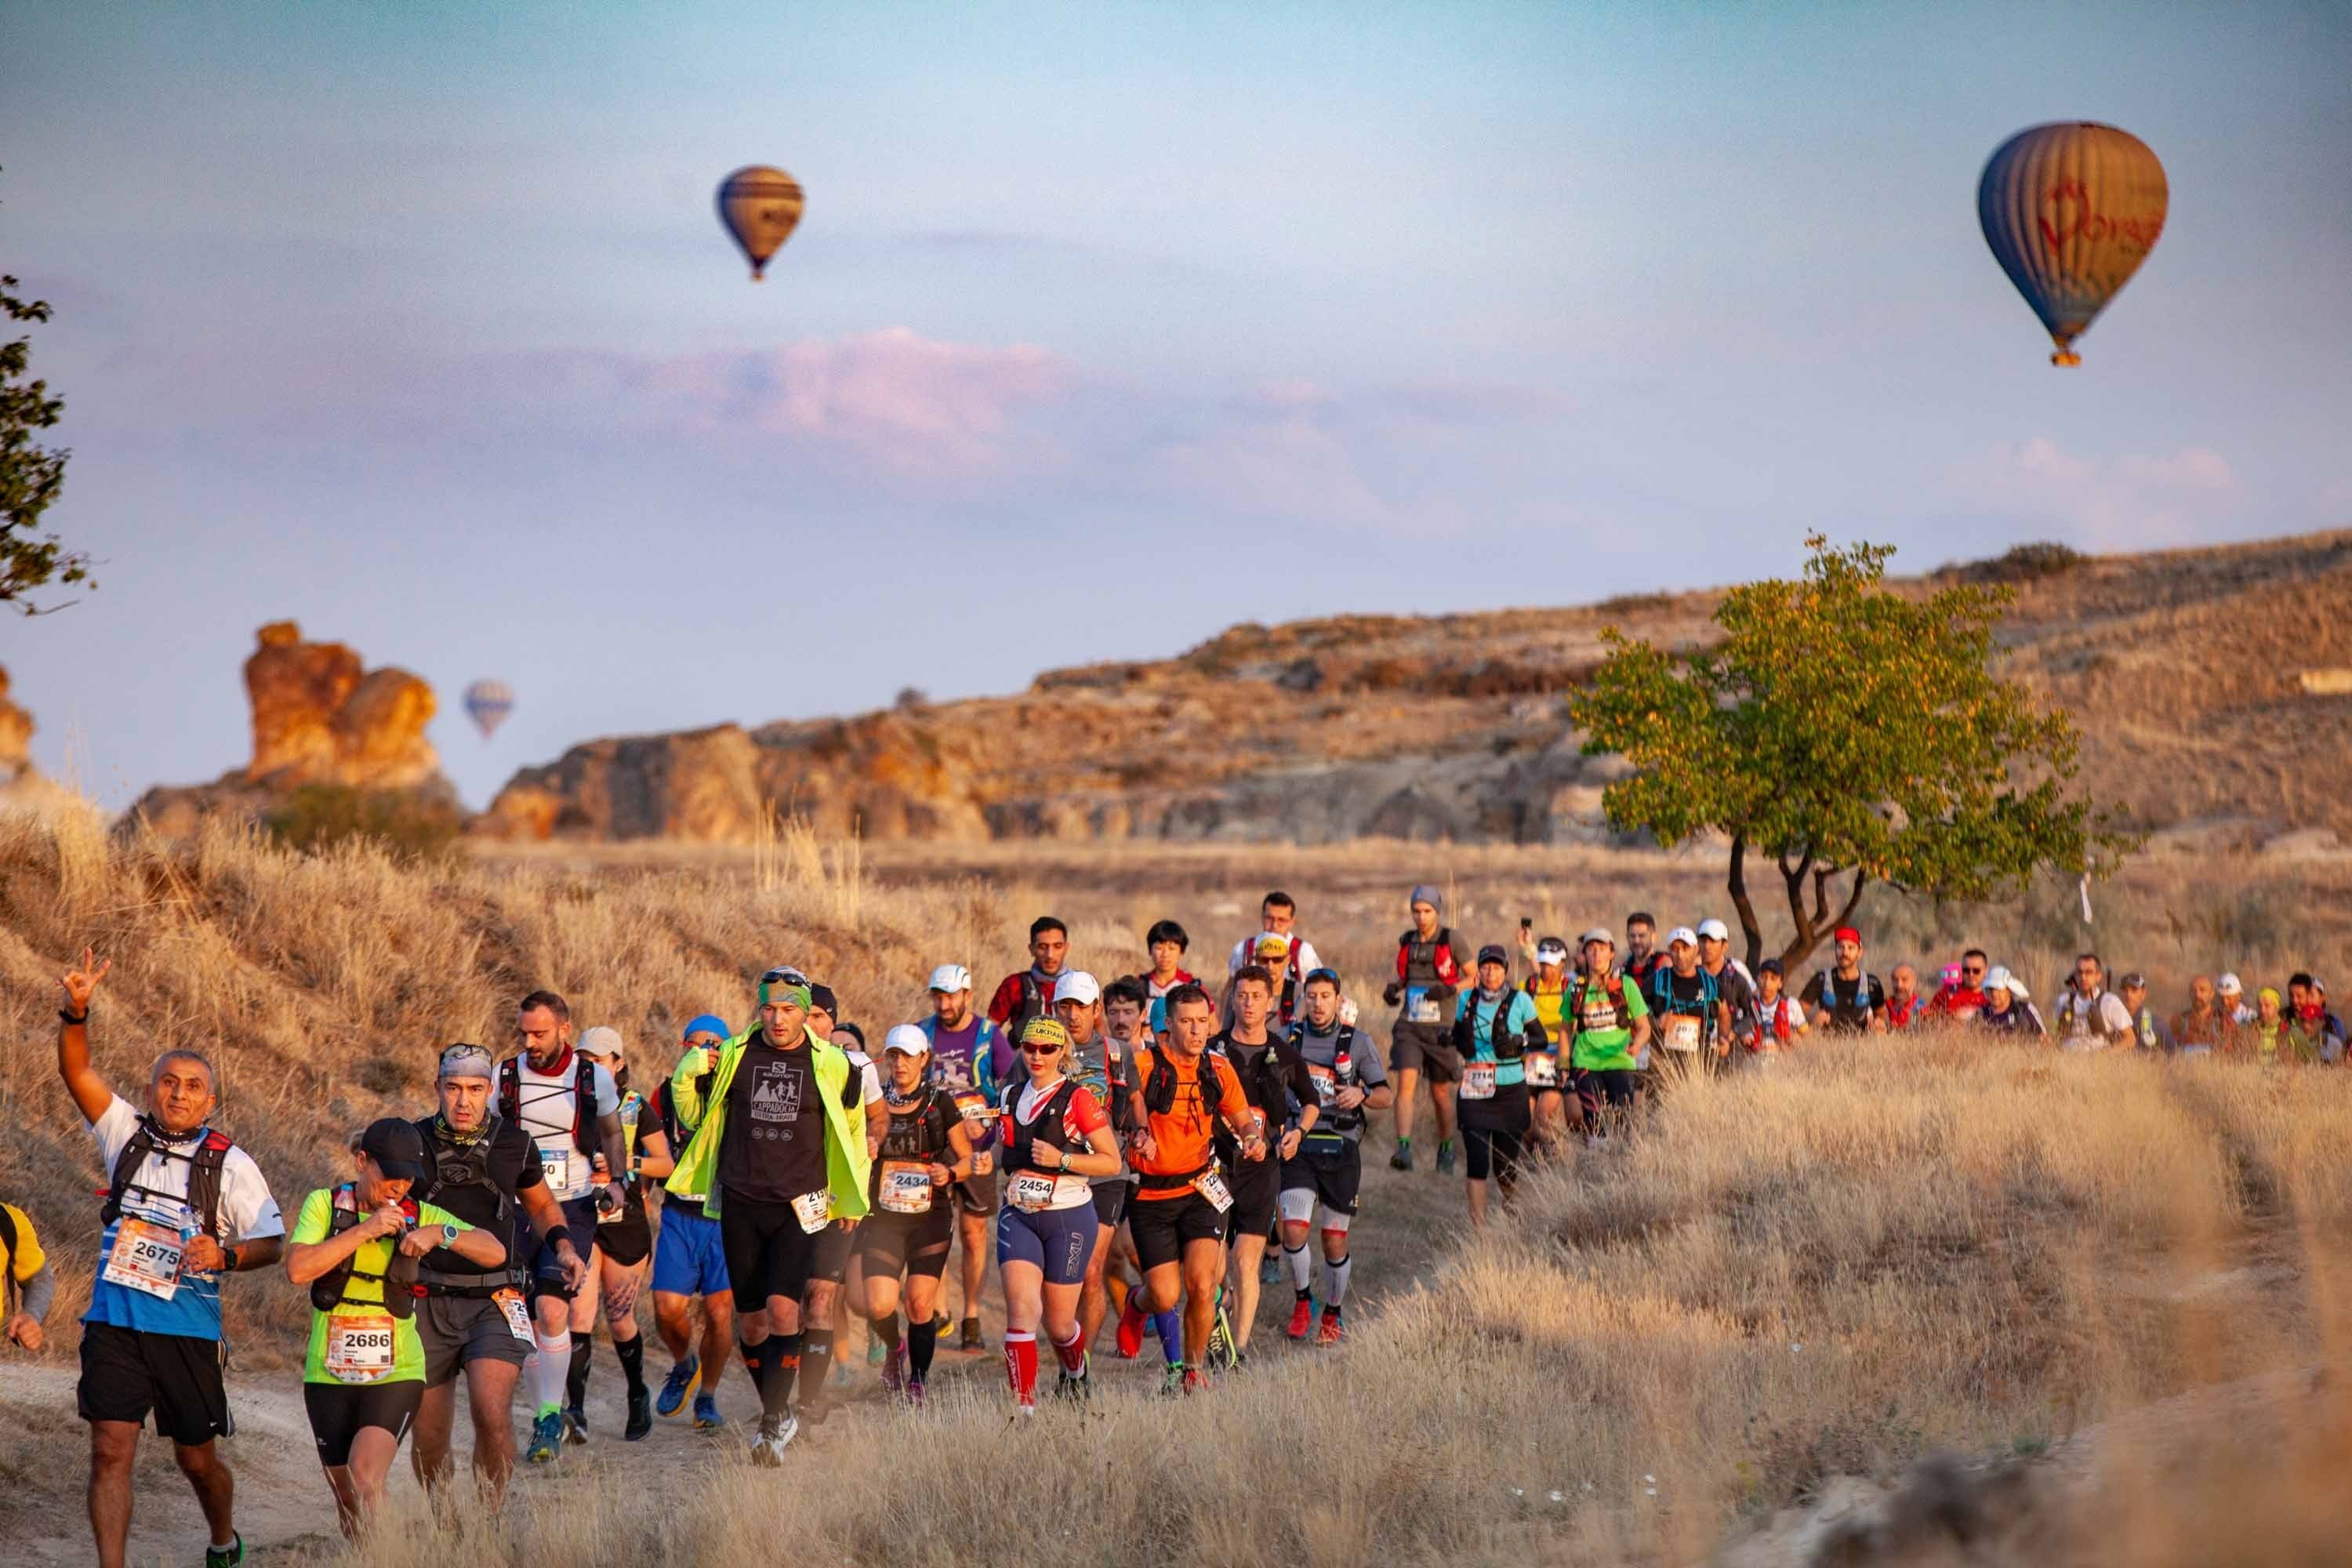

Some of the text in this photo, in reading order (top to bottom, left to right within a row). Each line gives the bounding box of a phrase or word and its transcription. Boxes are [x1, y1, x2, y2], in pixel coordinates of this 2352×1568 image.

[753, 1102, 795, 1113] CAPPADOCIA
[896, 1174, 928, 1188] 2434
[1019, 1179, 1051, 1193] 2454
[134, 1241, 180, 1265] 2675
[1066, 1232, 1084, 1277] 2XU
[345, 1334, 390, 1348] 2686
